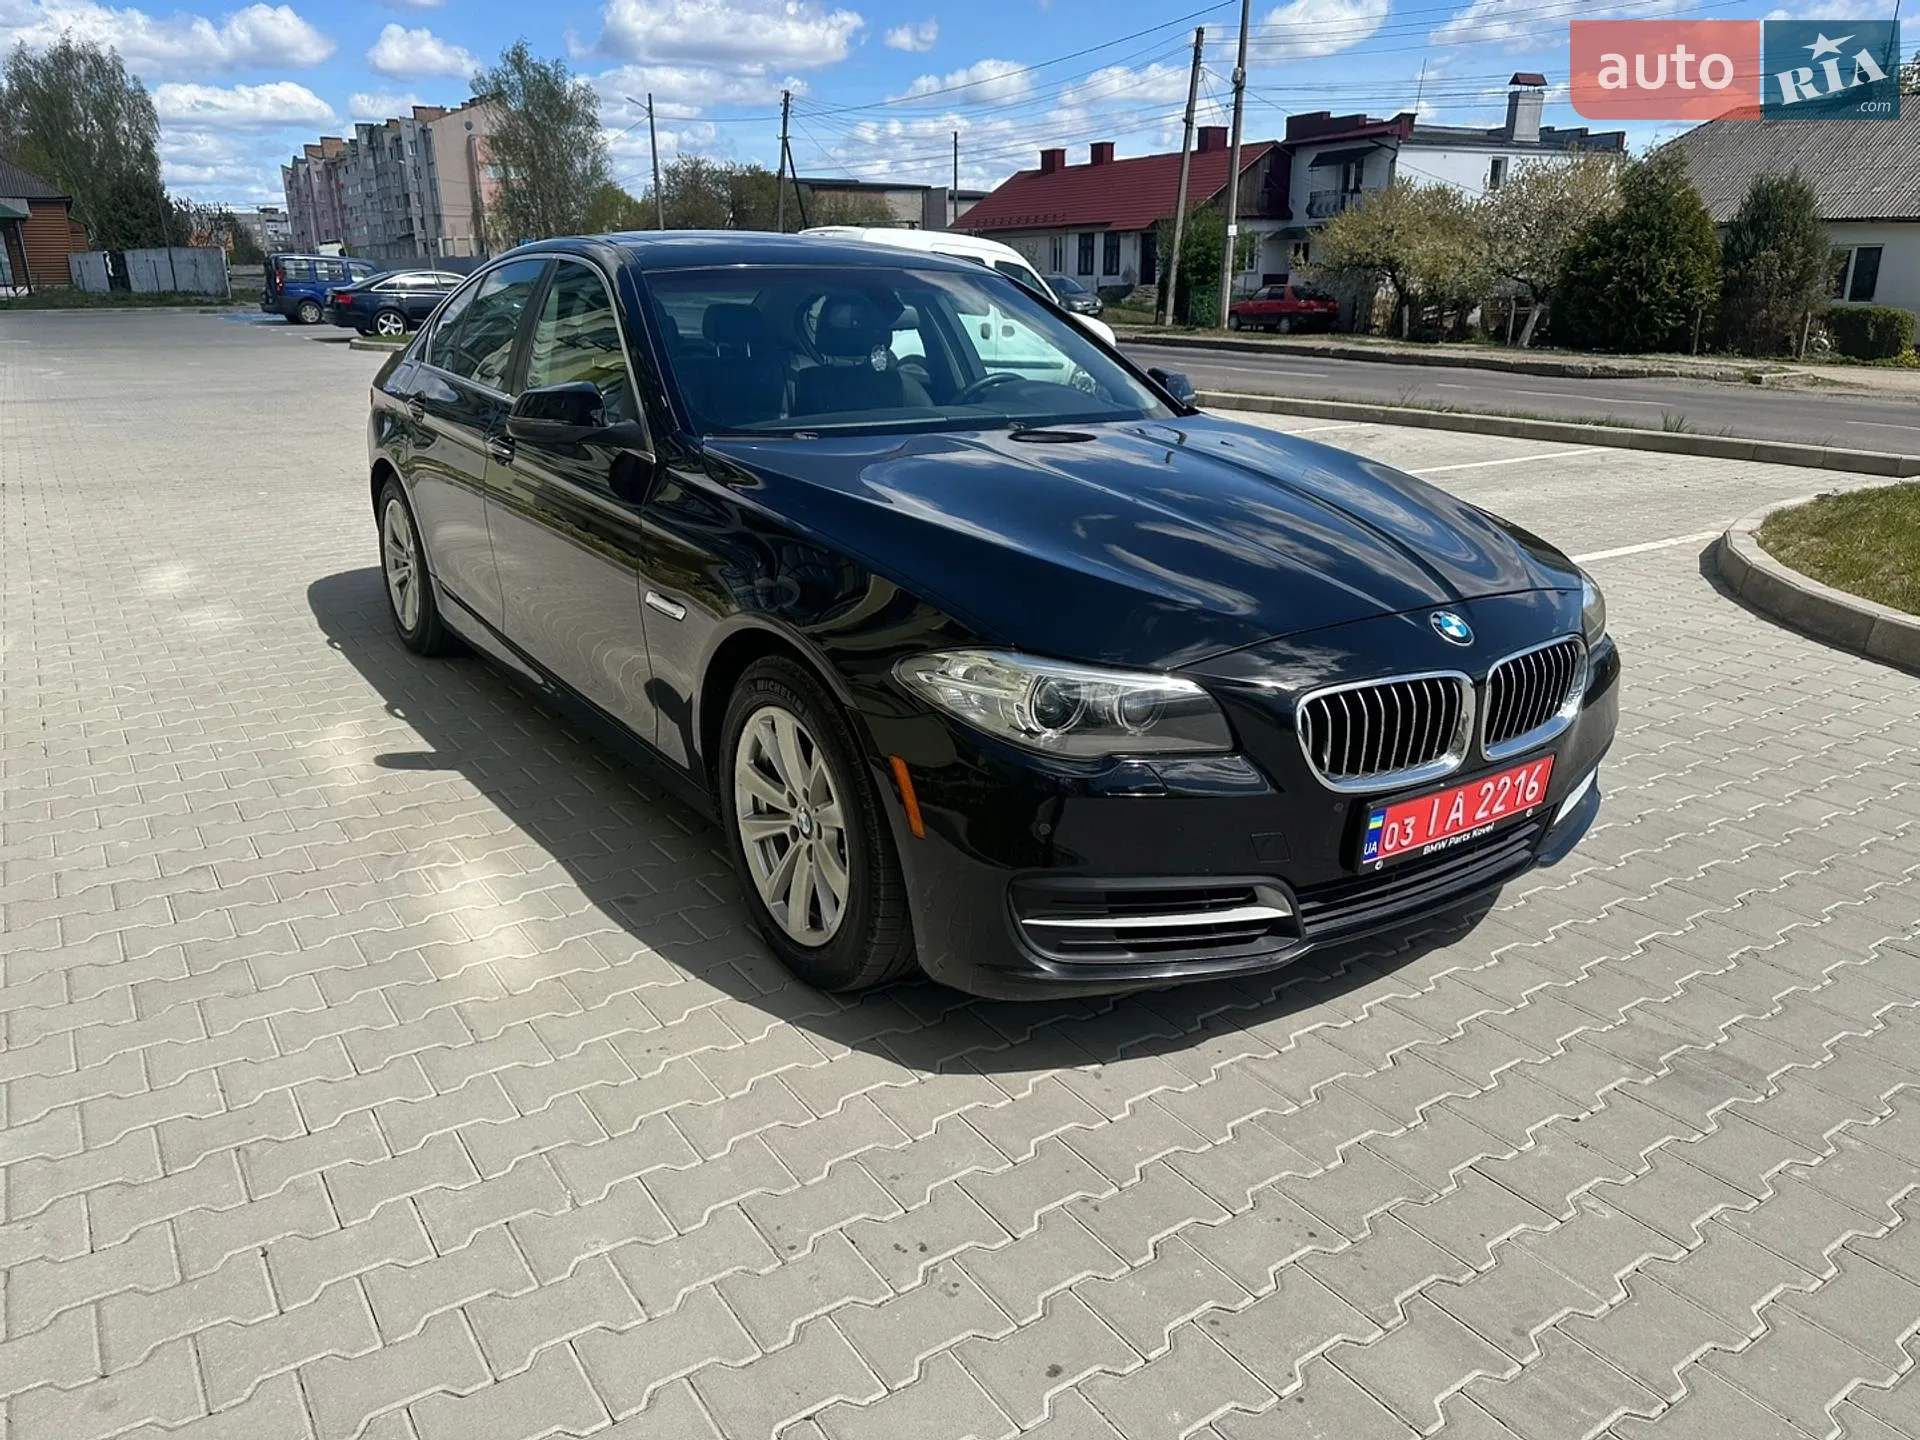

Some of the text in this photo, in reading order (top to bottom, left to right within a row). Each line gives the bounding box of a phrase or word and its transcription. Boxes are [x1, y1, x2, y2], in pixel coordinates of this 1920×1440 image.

[1383, 763, 1543, 850] 03 IA 2216
[1363, 841, 1378, 854] UA
[1422, 822, 1495, 856] BMW Parts Kovel
